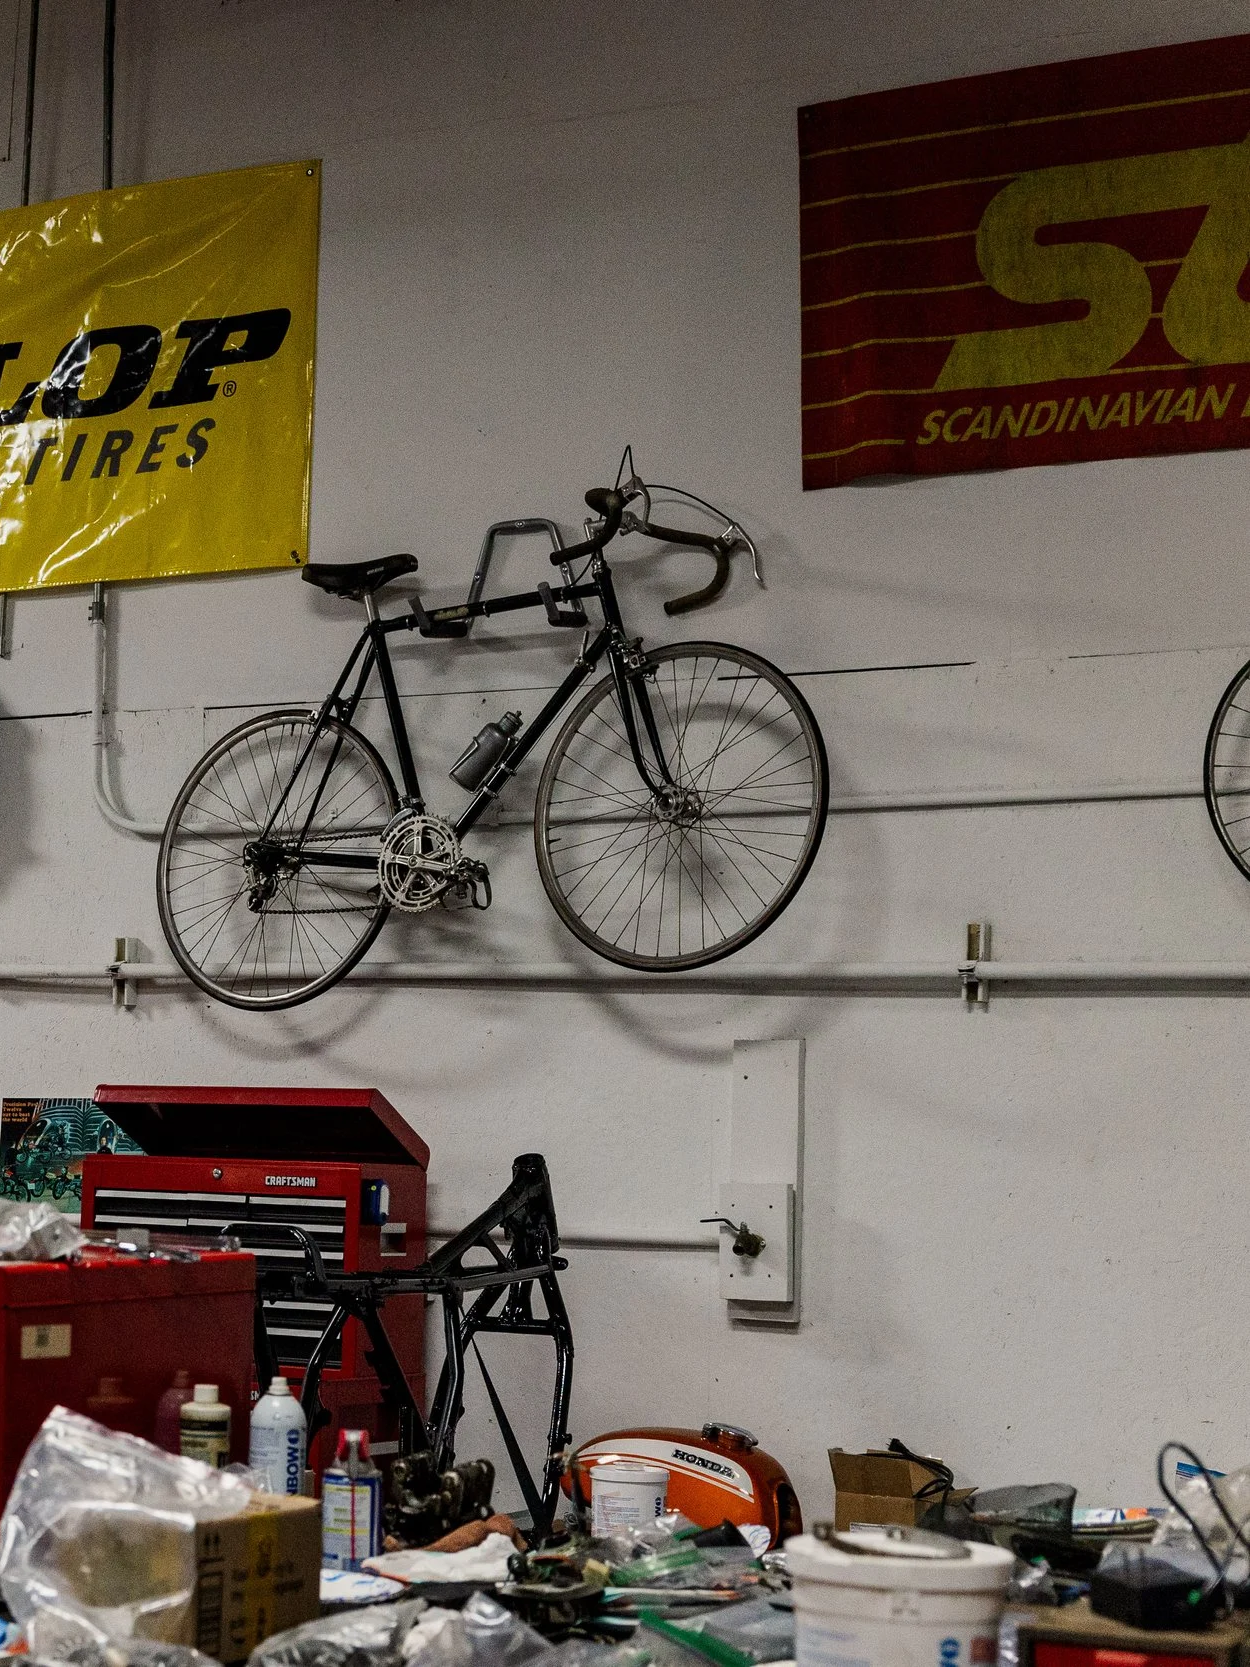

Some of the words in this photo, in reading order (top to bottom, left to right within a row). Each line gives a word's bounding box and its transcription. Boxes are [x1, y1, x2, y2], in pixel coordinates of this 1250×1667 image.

[916, 383, 1237, 445] SCANDINAVIAN
[24, 417, 216, 485] TIRES
[265, 1175, 316, 1187] CRAFTSMAN
[672, 1449, 737, 1479] HONDA
